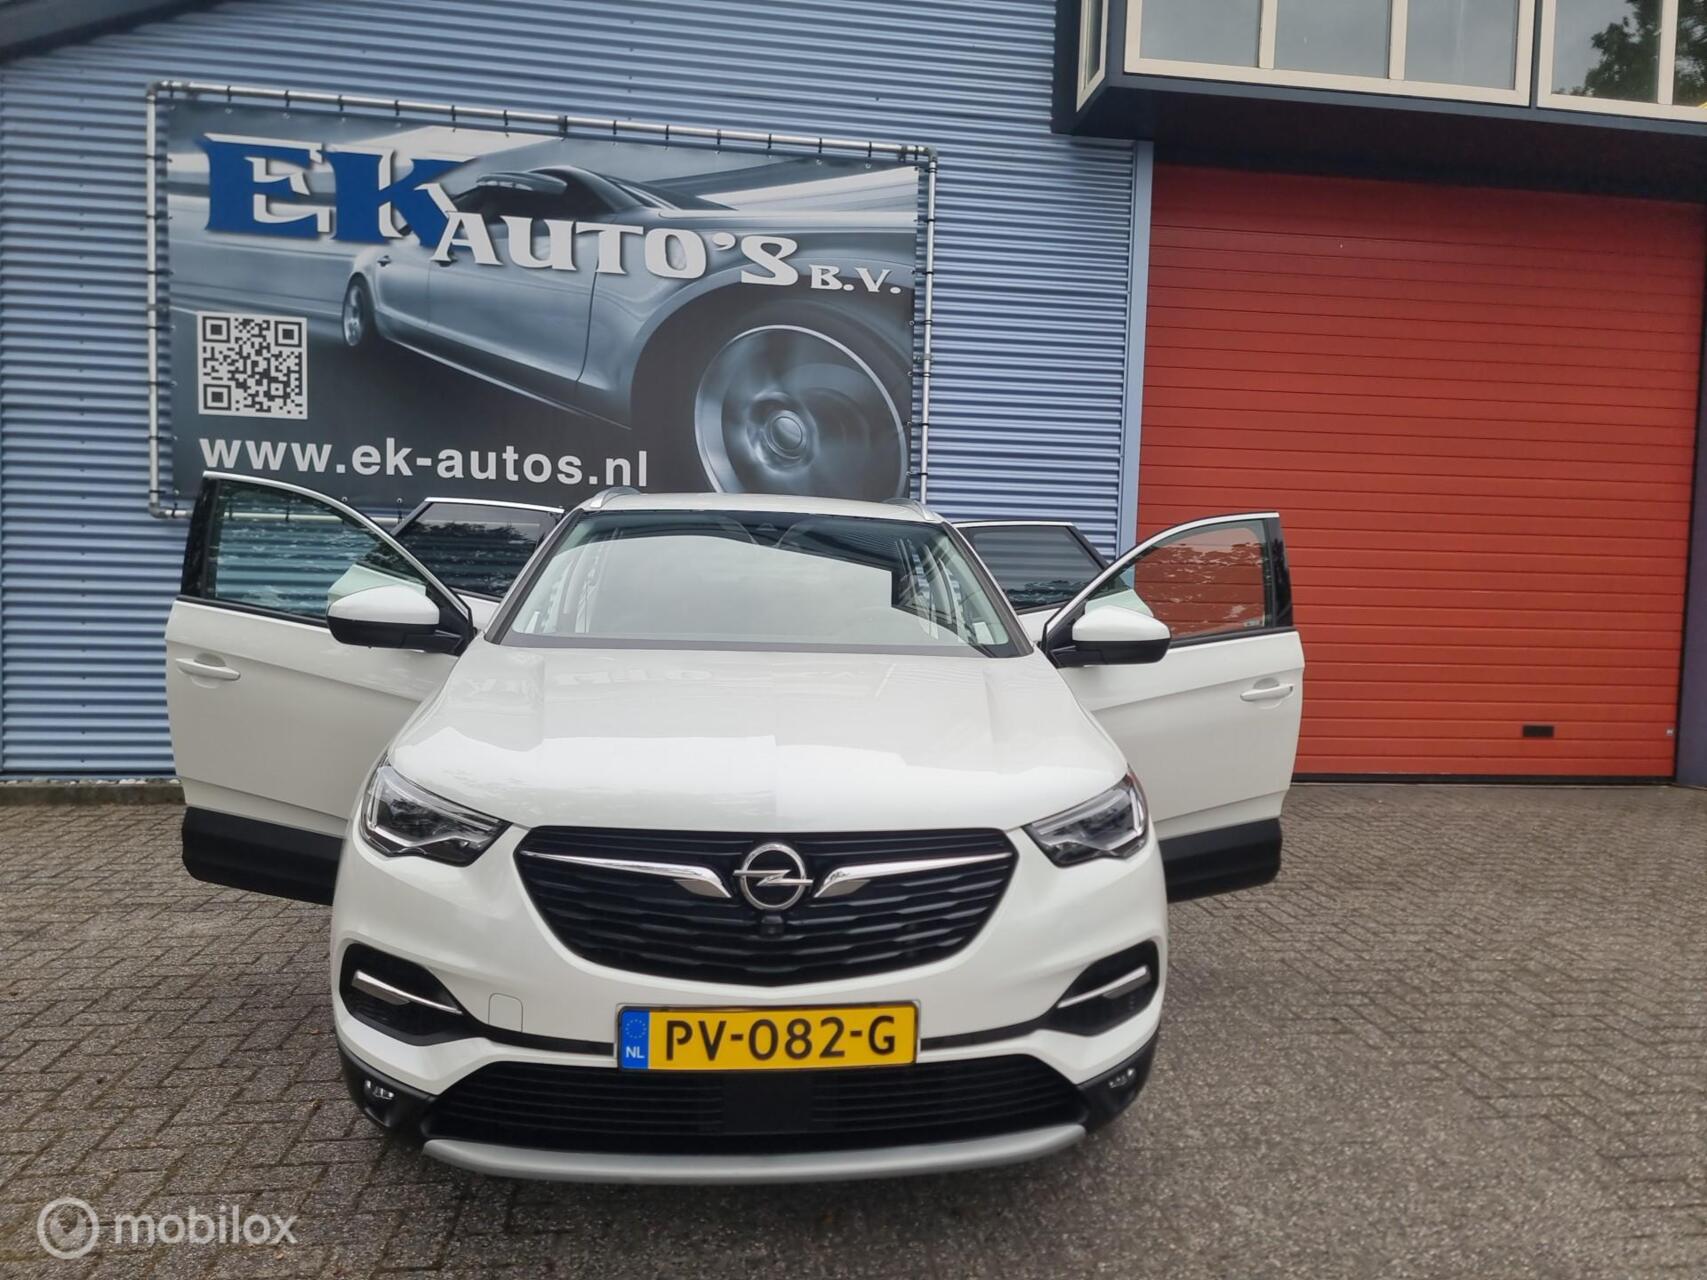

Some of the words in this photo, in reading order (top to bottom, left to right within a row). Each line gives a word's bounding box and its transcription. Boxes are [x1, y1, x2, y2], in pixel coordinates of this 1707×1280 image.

[195, 133, 478, 249] EK
[808, 264, 902, 294] B.V.
[199, 437, 648, 487] www.ek-autos.nl
[625, 1045, 645, 1059] NL
[665, 1015, 896, 1061] PV-082-G
